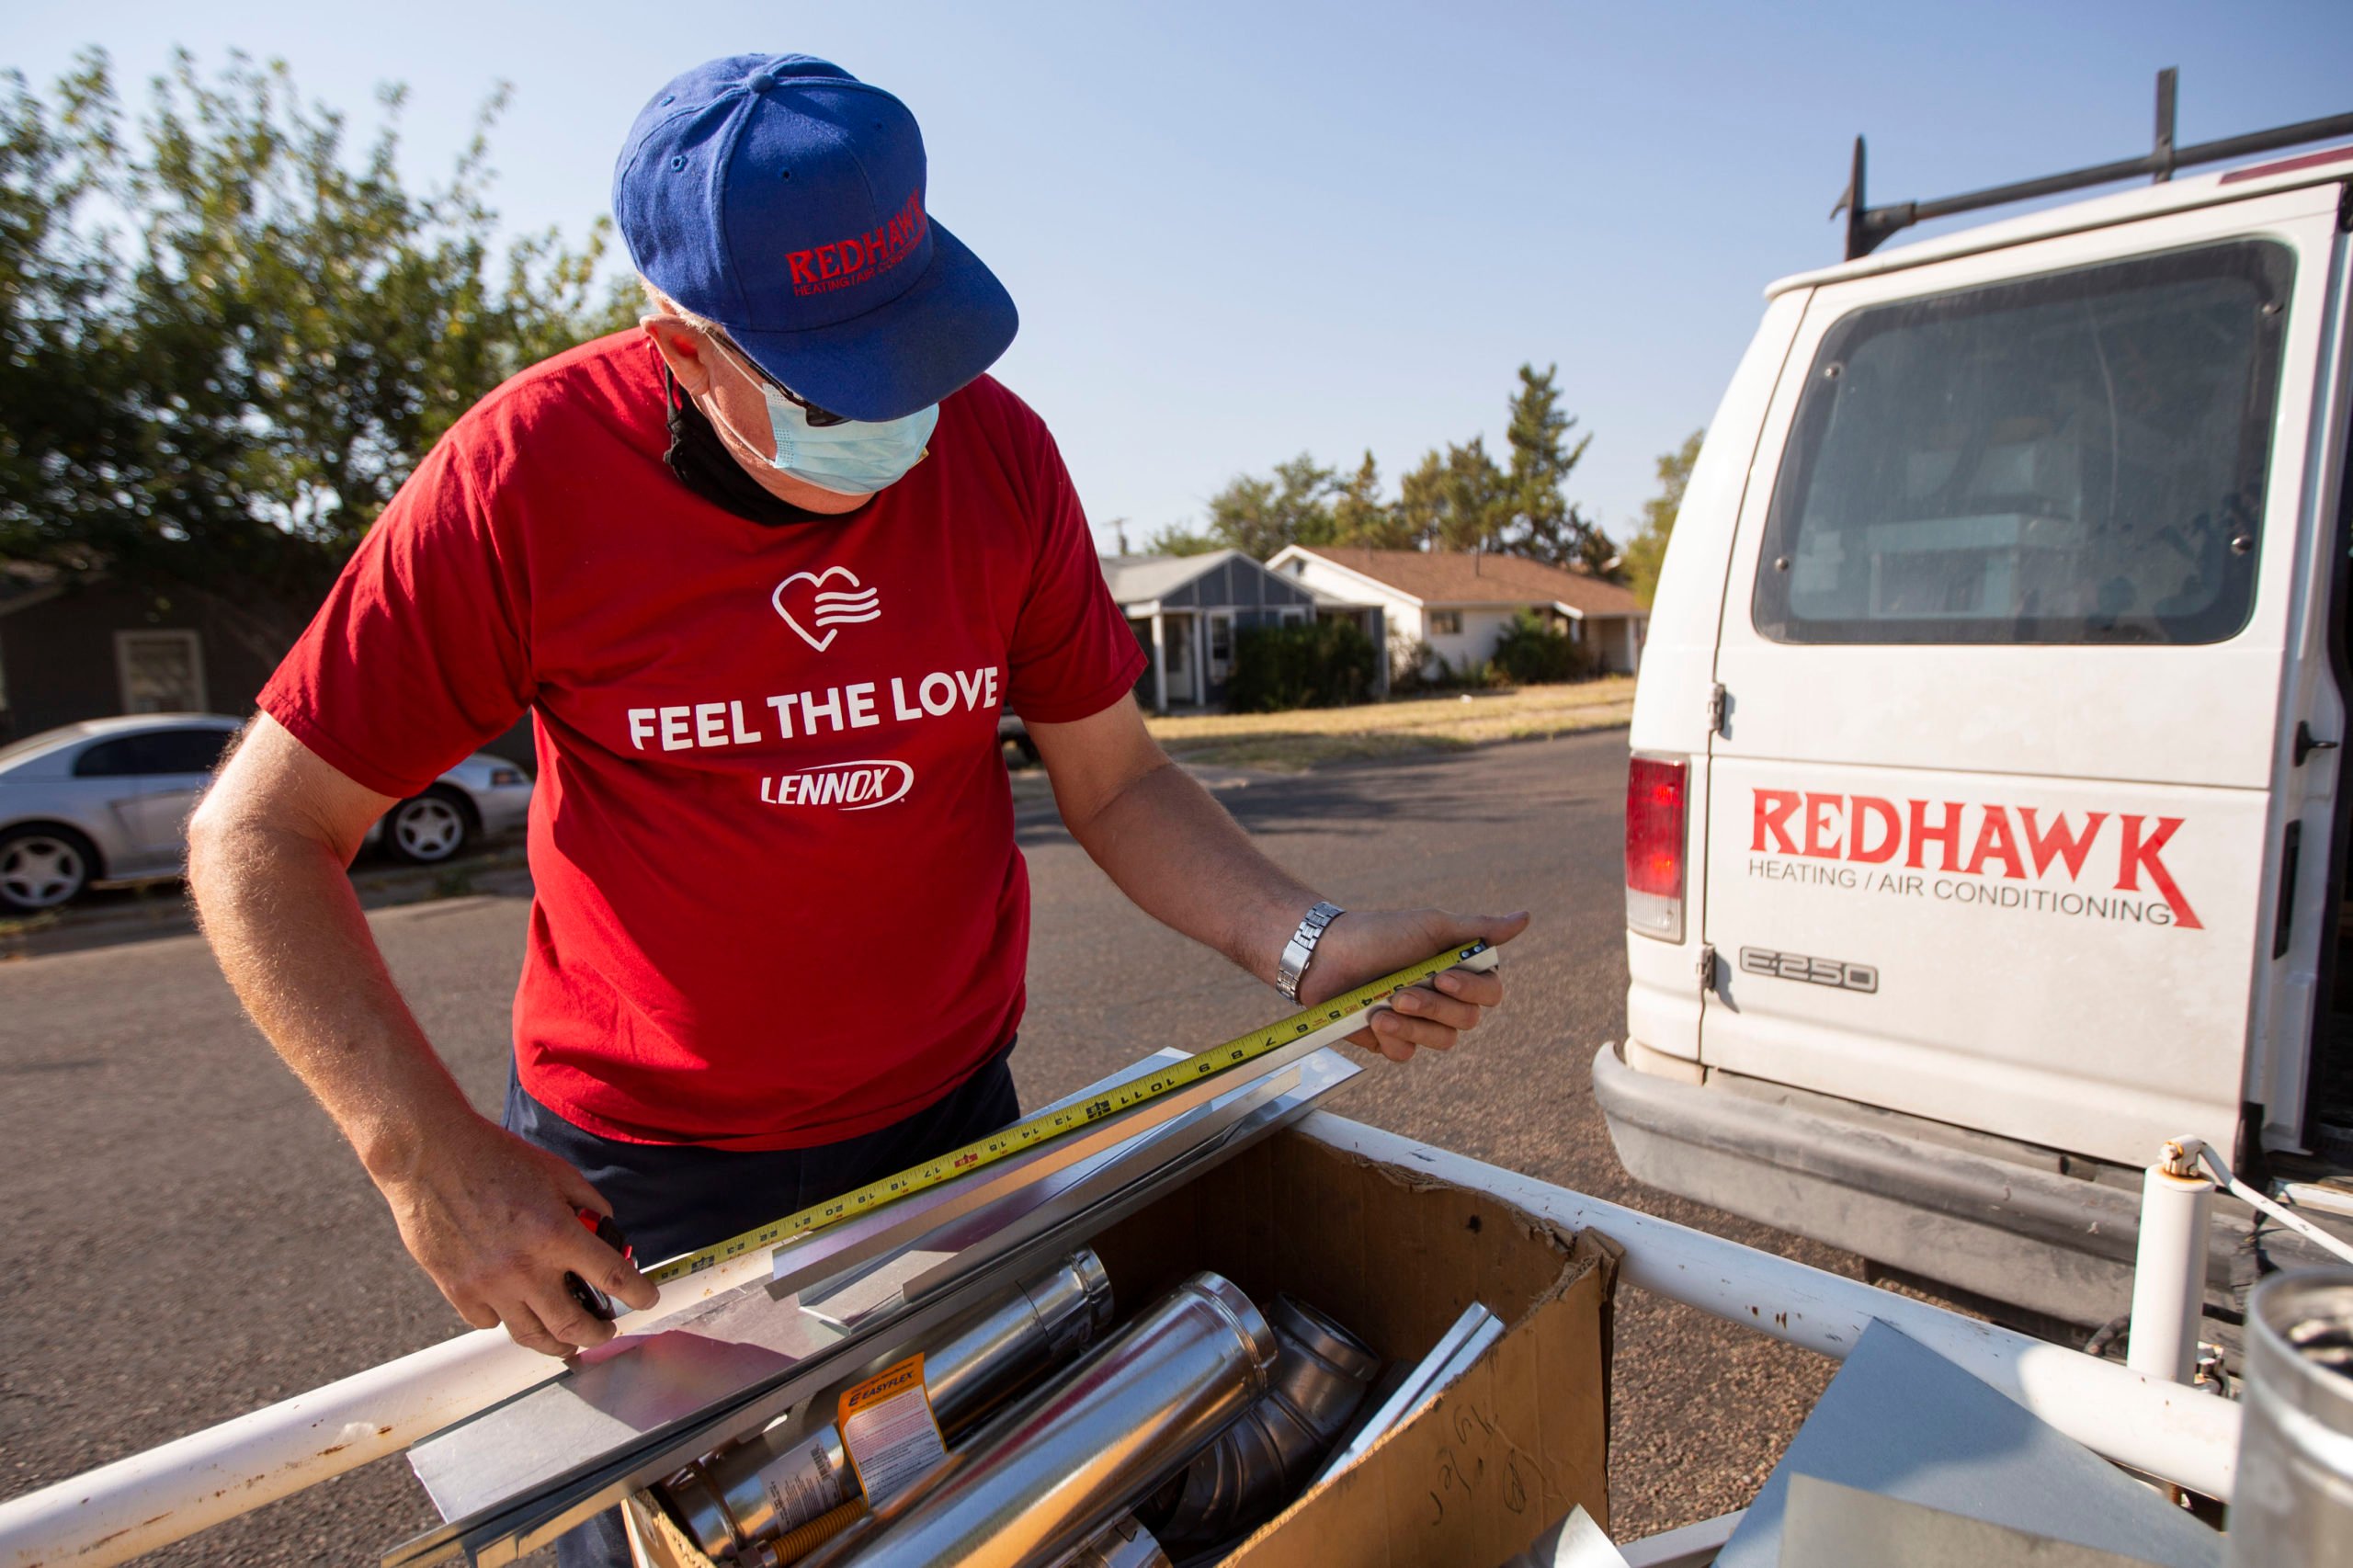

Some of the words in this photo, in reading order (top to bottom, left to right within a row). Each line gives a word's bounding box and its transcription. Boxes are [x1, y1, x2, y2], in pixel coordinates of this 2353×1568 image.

[785, 187, 926, 284] REDHAWK
[793, 278, 850, 296] HEATING
[628, 699, 762, 752] FEEL
[767, 682, 881, 740] THE
[891, 666, 999, 722] LOVE
[761, 767, 890, 806] LENNOX
[1750, 787, 2206, 930] REDHAWK
[1748, 858, 1859, 891] HEATING
[1878, 873, 1925, 898] AIR
[1933, 878, 2174, 926] CONDITIONING
[1361, 998, 1373, 1006] 4
[1231, 1050, 1244, 1060] 8
[1266, 1037, 1277, 1047] 7
[1151, 1078, 1176, 1092] 10
[862, 1370, 913, 1400] EASYFLEX
